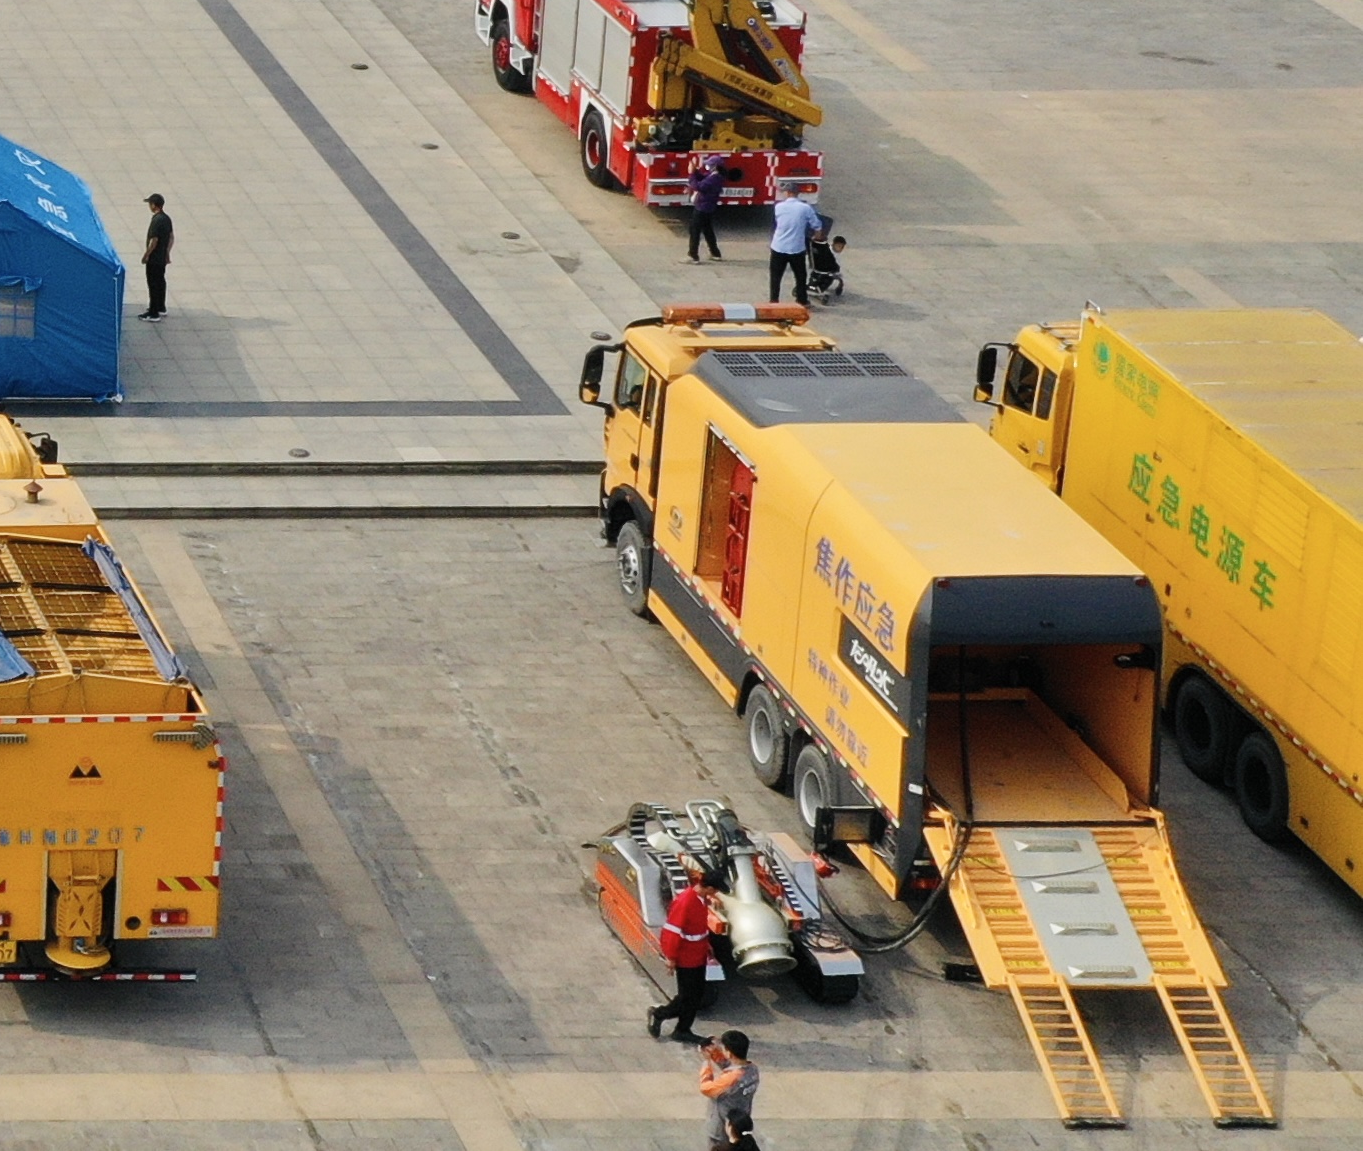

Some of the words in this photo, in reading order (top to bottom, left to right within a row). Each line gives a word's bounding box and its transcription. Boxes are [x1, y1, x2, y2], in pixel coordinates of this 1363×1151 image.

[813, 535, 894, 652] 焦作应急
[1128, 452, 1277, 612] 应急电源车
